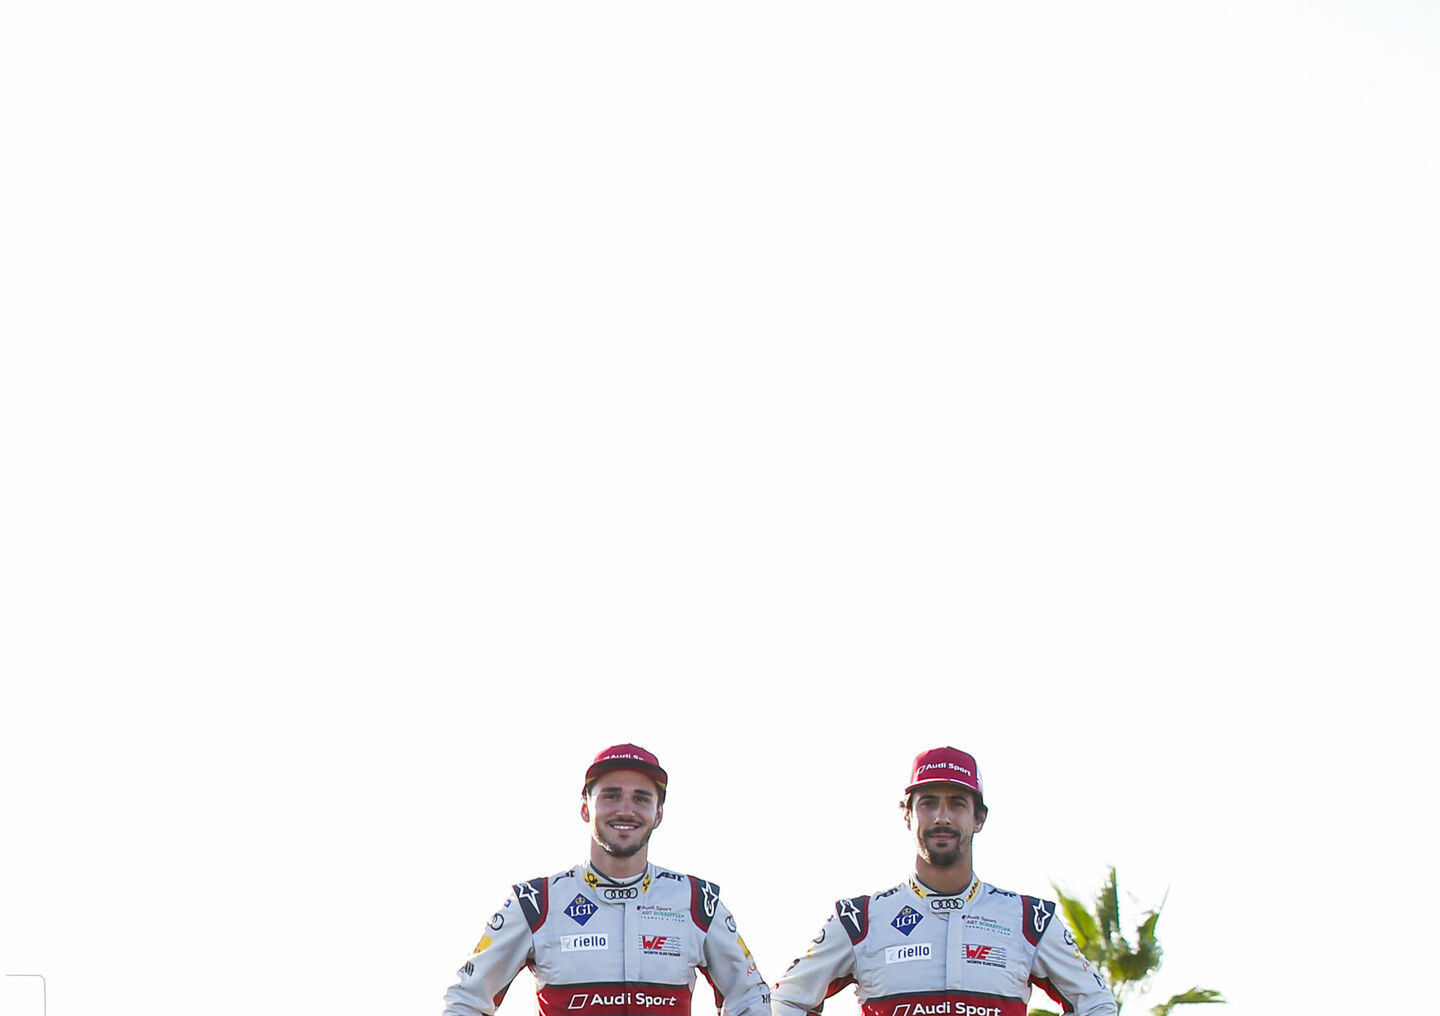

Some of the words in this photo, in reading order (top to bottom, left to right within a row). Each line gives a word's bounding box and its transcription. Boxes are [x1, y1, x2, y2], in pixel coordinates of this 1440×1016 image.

[926, 762, 947, 770] Audi
[948, 763, 971, 777] Sport
[570, 904, 593, 917] LGT
[896, 913, 919, 928] LGT
[573, 936, 607, 948] riello
[897, 944, 930, 960] riello
[590, 992, 633, 1006] Audi
[636, 993, 677, 1010] Sport
[912, 1000, 951, 1016] Audi
